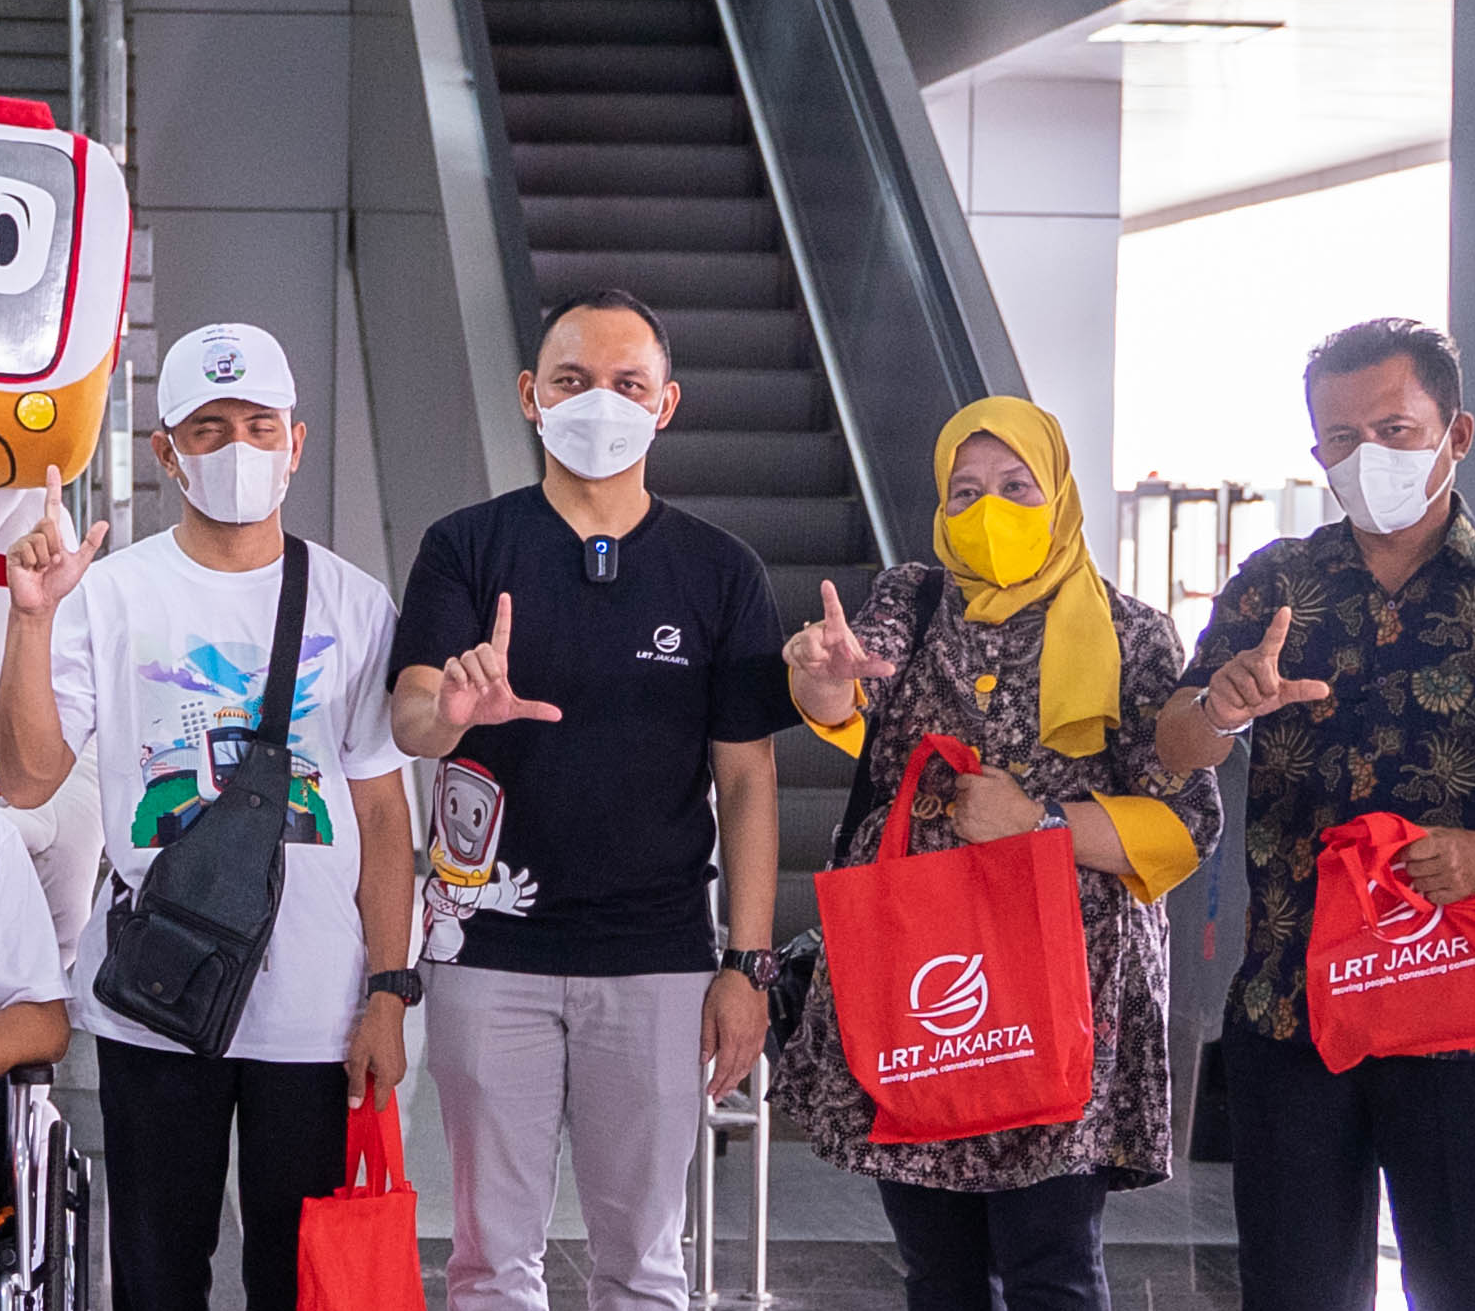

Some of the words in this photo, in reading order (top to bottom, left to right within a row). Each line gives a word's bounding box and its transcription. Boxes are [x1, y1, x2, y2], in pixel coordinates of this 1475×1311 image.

[636, 651, 653, 659] LRT
[653, 653, 689, 666] JAKARTA
[1329, 953, 1378, 983] LRT
[1384, 936, 1469, 970] JAKAR
[1331, 982, 1363, 996] moving
[1365, 975, 1397, 990] people,
[1398, 963, 1447, 983] connecting
[878, 1045, 924, 1072] LRT
[929, 1024, 1034, 1063] JAKARTA
[879, 1073, 908, 1084] moving
[910, 1066, 939, 1080] people,
[940, 1057, 984, 1073] connecting
